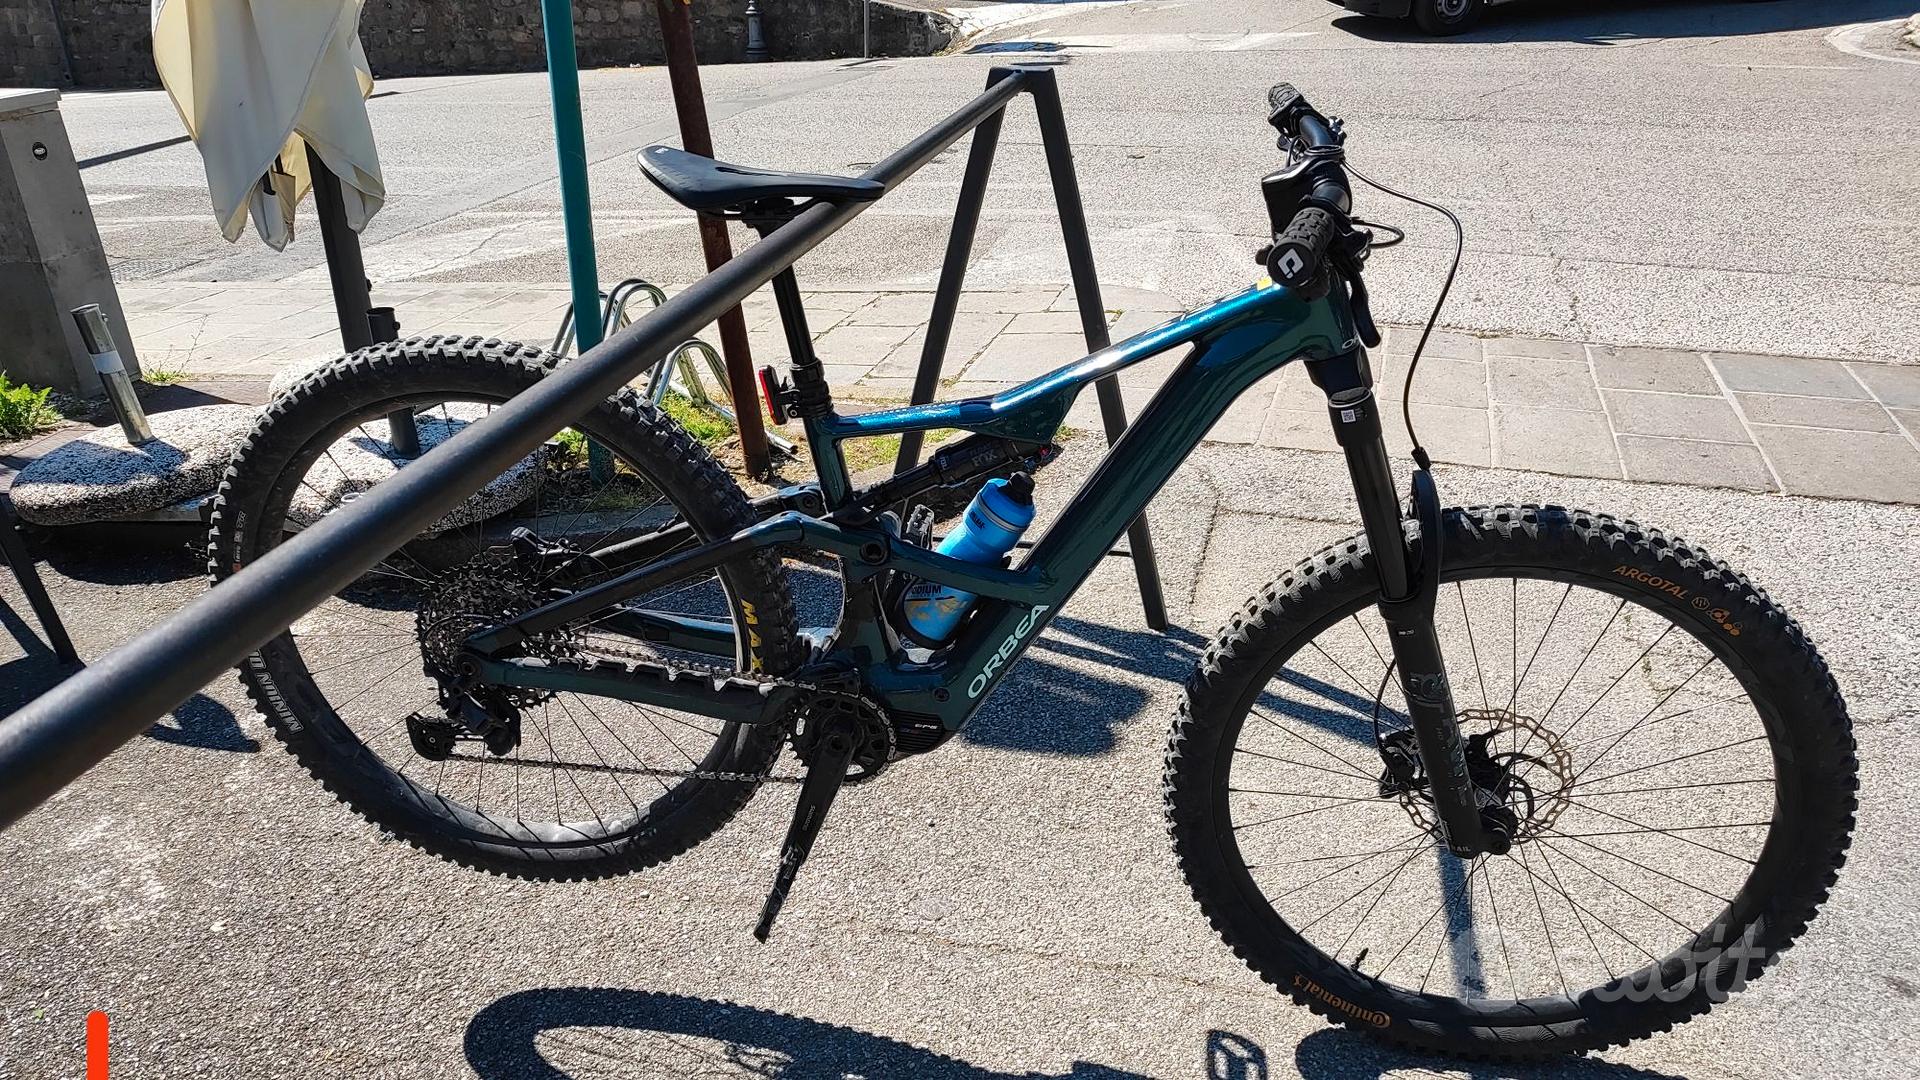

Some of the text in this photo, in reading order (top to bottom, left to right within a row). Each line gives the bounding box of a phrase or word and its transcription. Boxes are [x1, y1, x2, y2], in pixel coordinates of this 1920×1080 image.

[1612, 565, 1689, 600] ARGOTAL
[967, 604, 1050, 699] ORBEA
[1302, 980, 1391, 1029] Continental
